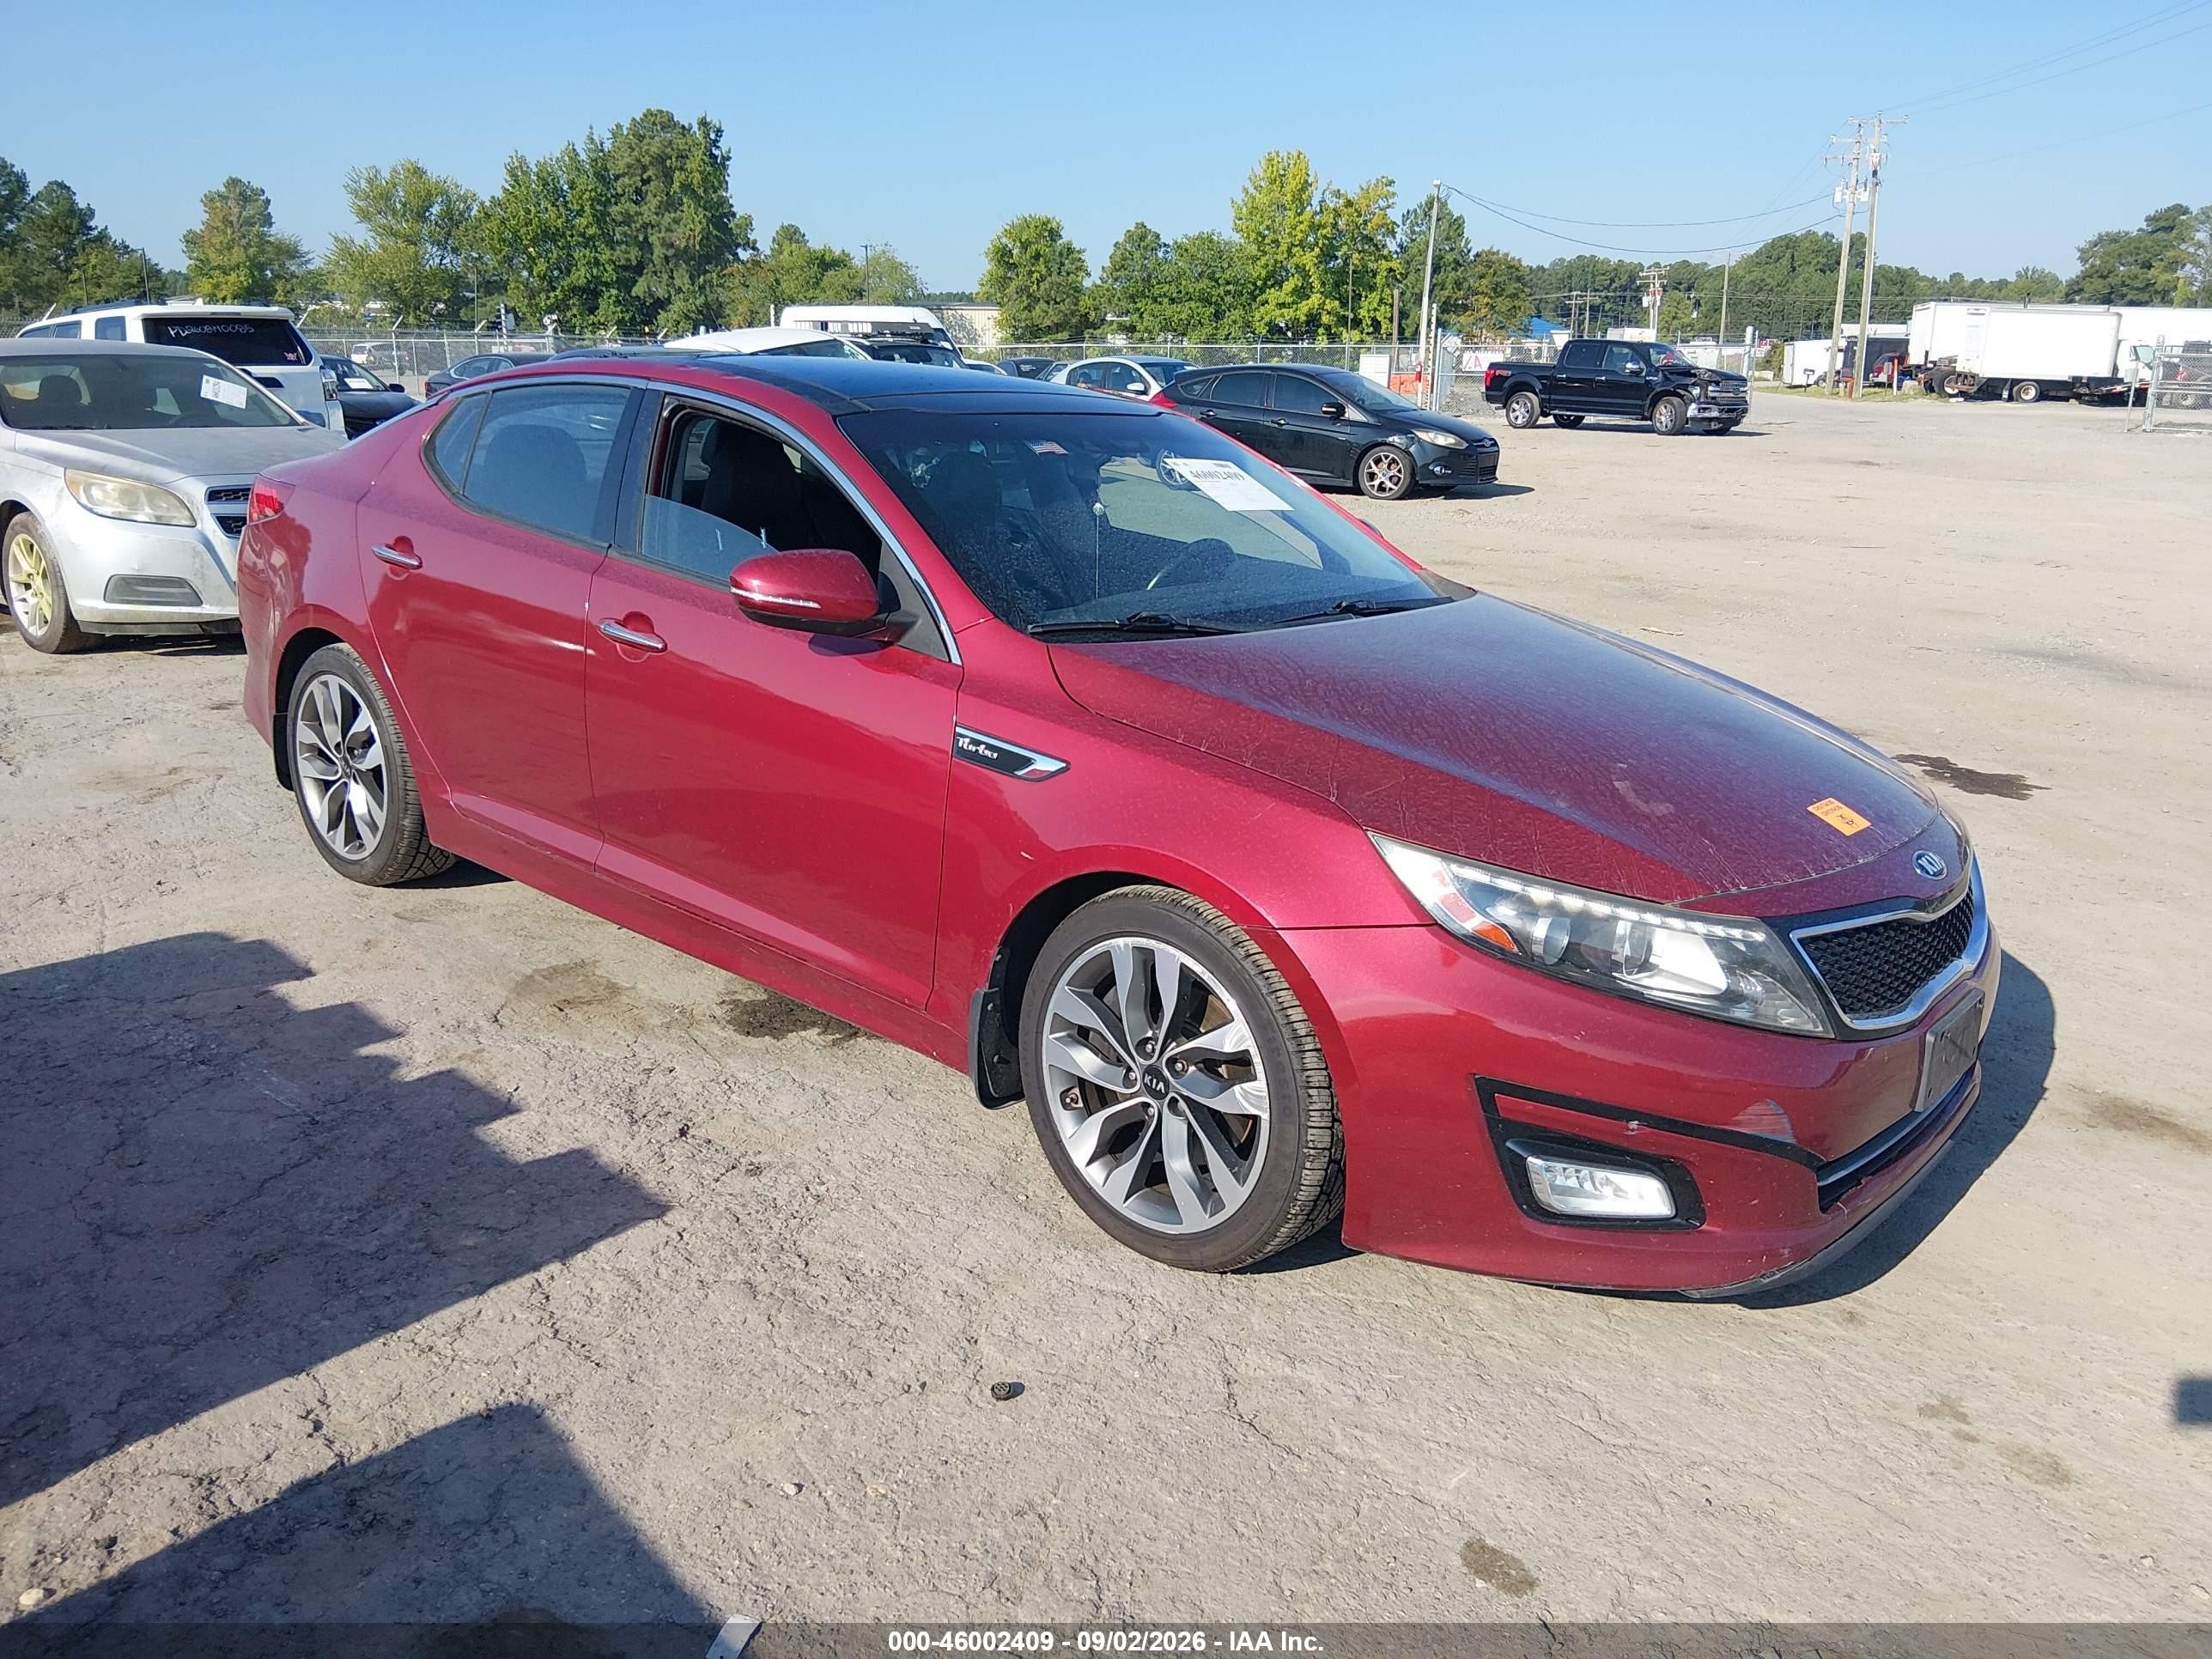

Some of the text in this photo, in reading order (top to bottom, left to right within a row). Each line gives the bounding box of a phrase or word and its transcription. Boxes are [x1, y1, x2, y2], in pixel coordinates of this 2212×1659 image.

[956, 736, 999, 760] Turbo
[1917, 853, 1946, 875] KIA
[1144, 1073, 1165, 1094] KIA
